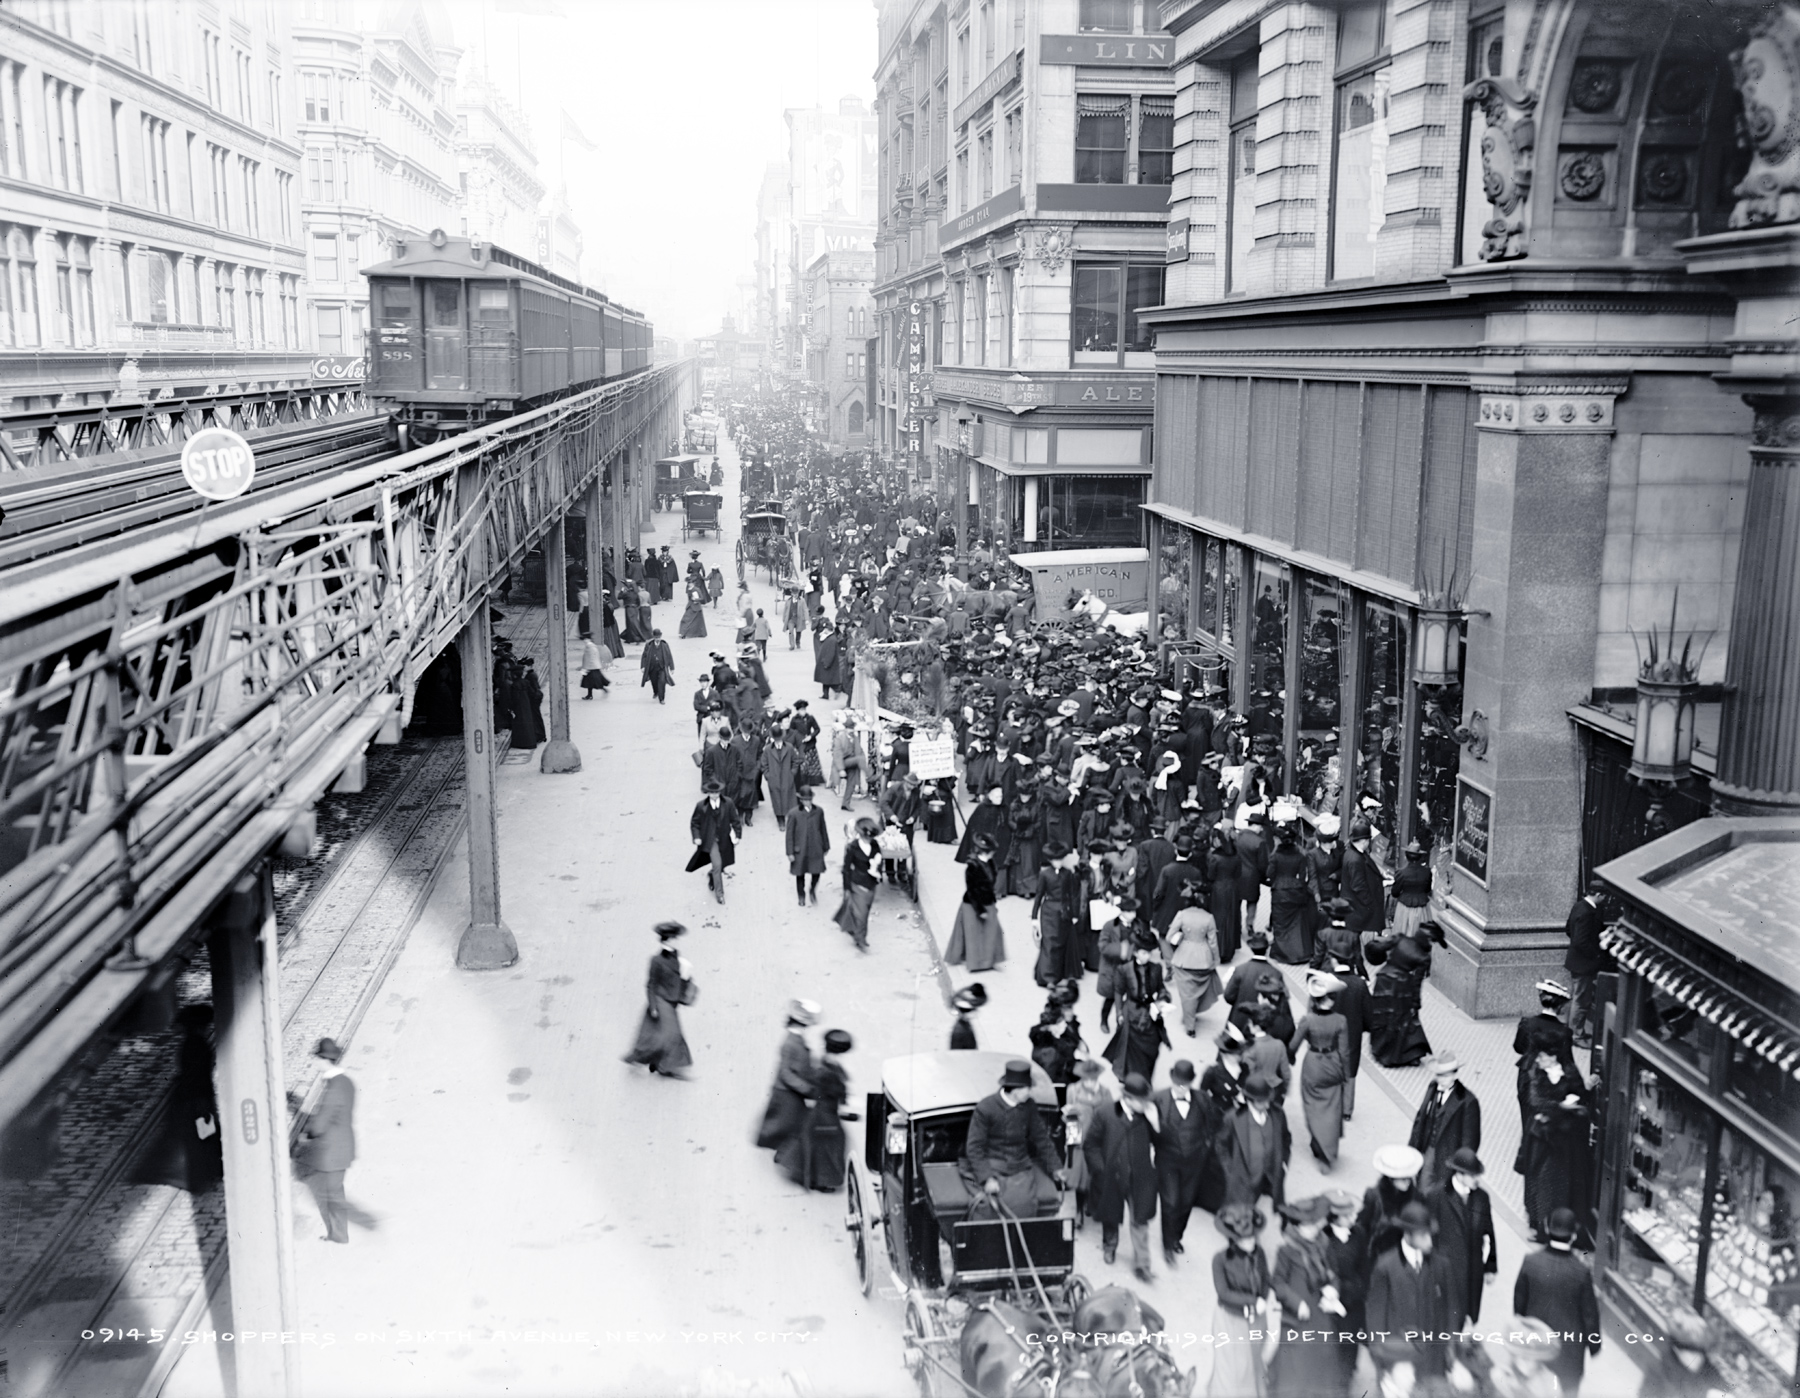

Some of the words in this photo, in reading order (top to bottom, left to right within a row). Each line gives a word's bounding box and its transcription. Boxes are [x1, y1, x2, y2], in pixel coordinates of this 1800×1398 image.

[382, 351, 413, 361] 898
[1081, 386, 1156, 402] ALE
[188, 445, 246, 483] STOP
[1053, 565, 1131, 583] AMERICAN
